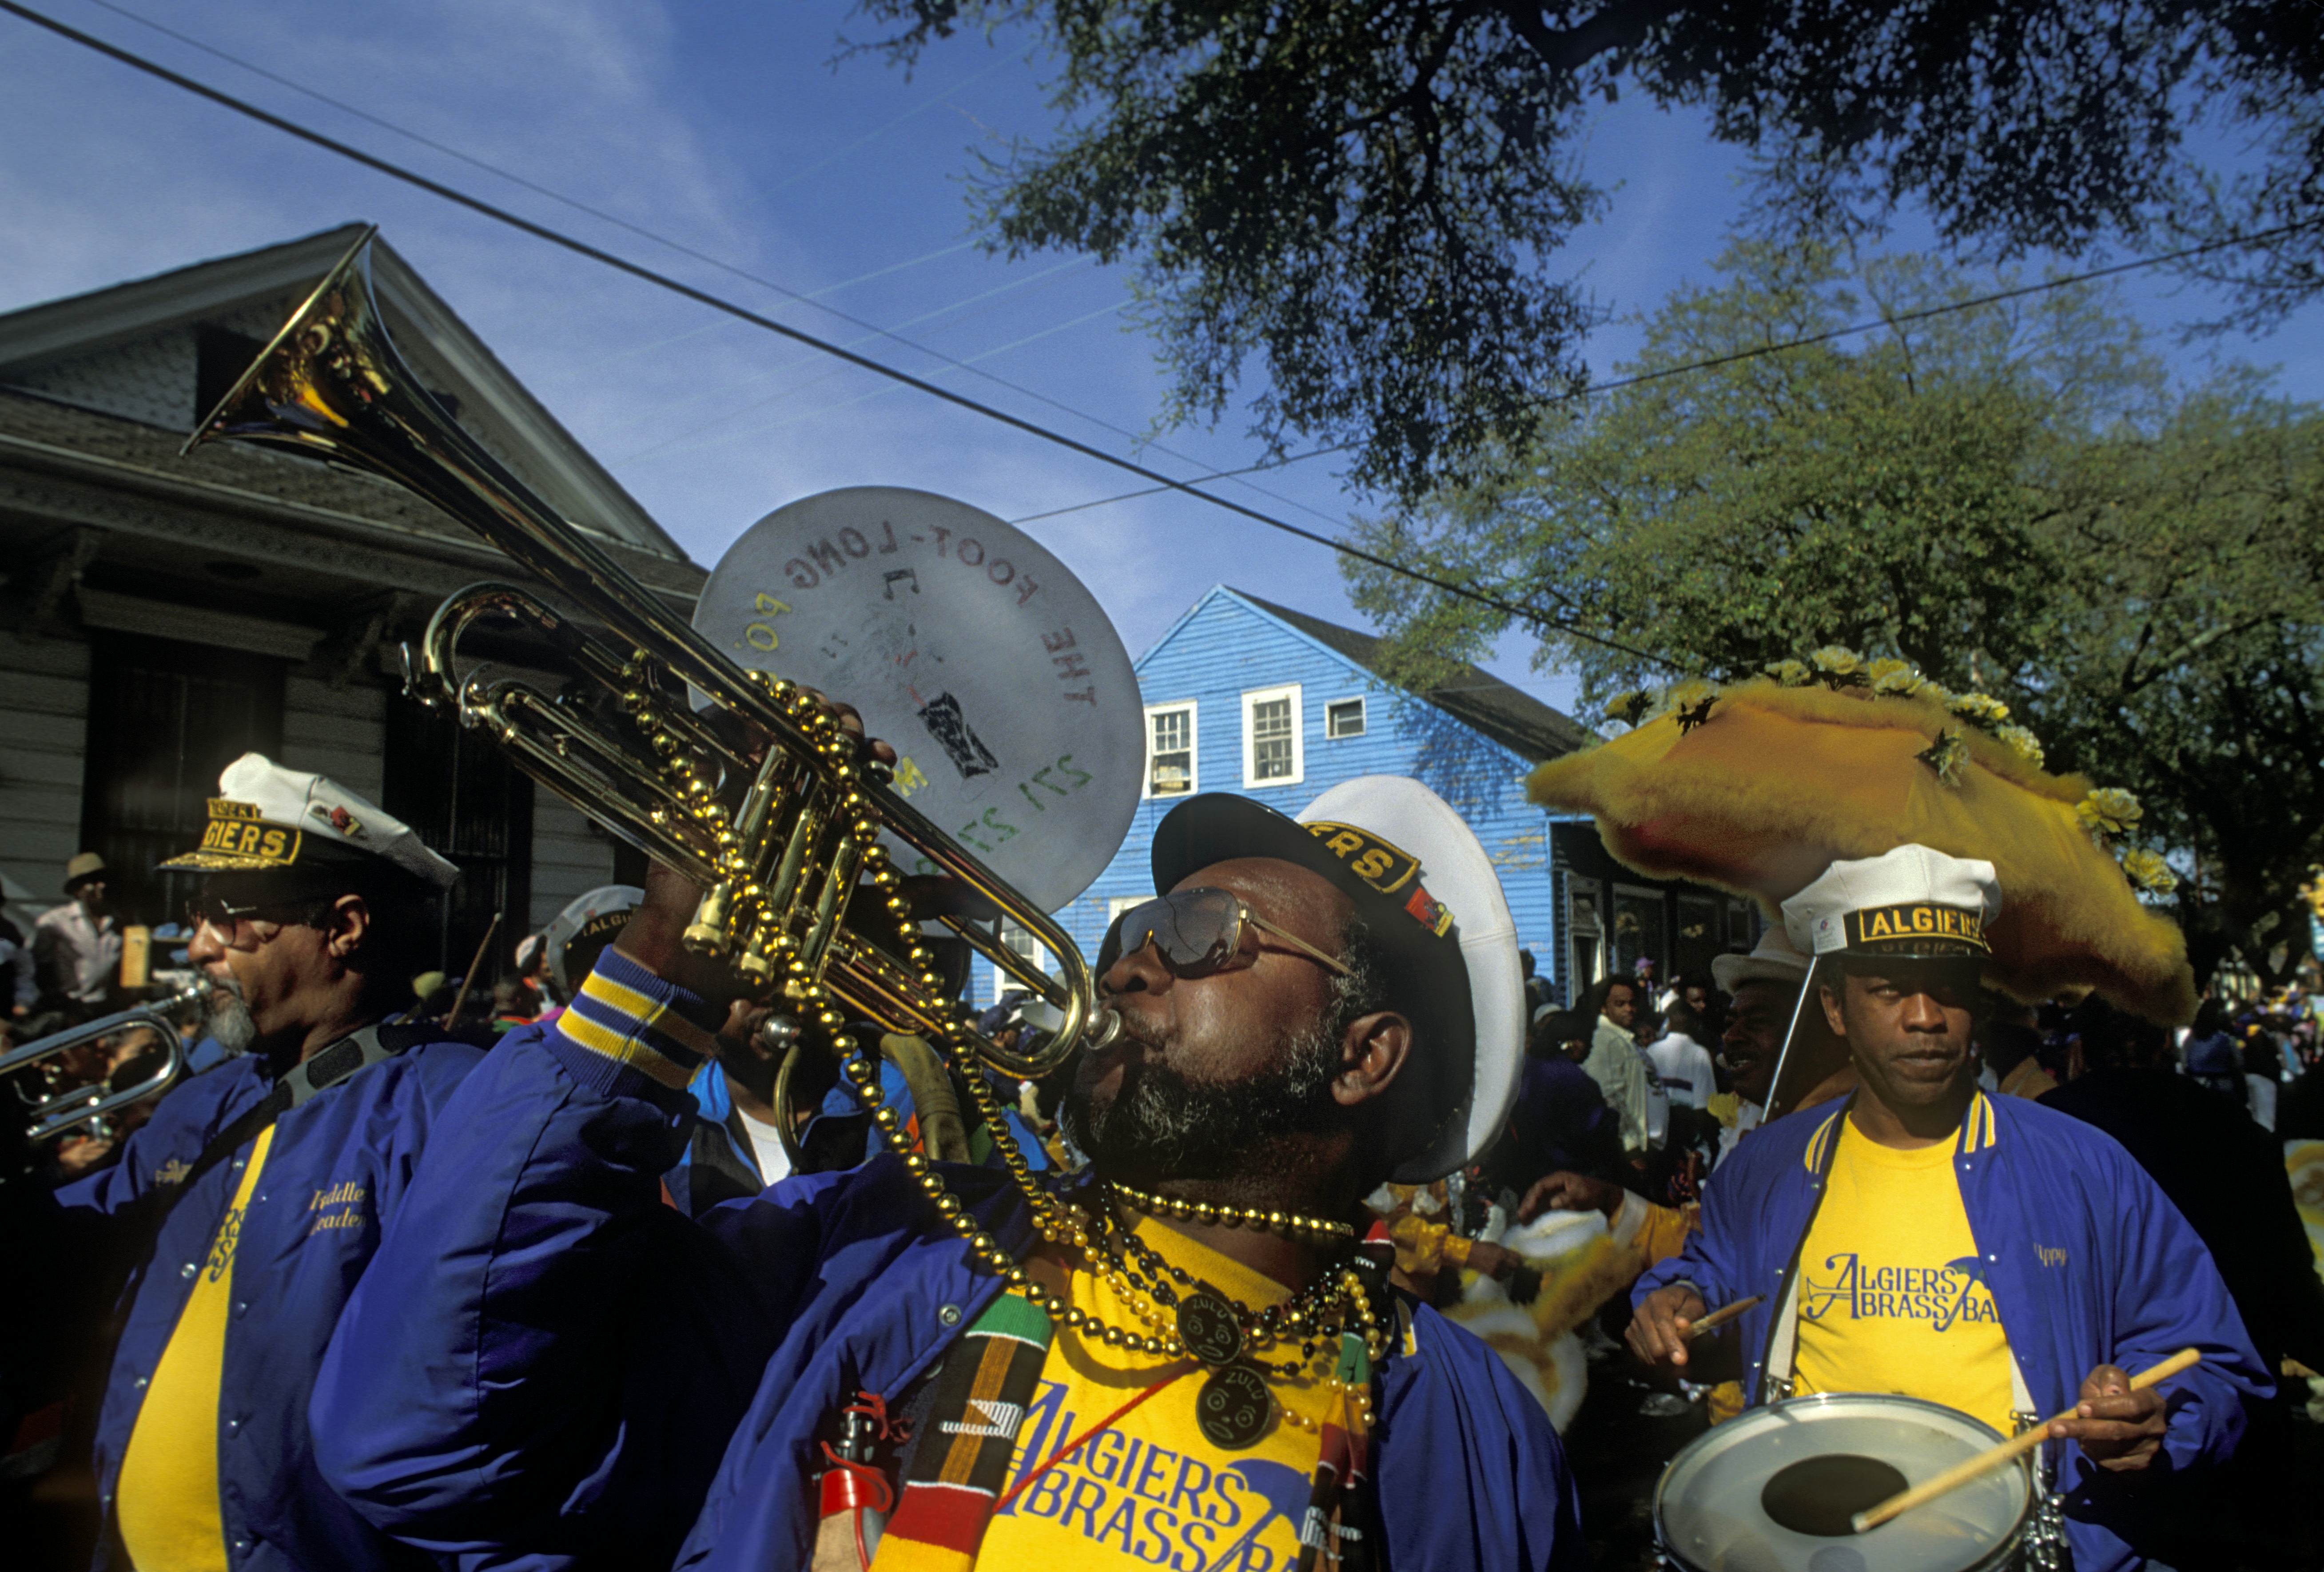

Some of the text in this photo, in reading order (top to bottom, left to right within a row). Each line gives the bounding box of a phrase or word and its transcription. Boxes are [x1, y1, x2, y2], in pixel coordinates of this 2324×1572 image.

[202, 820, 287, 857] GIERS
[589, 914, 631, 935] ALGI
[1806, 1253, 1957, 1320] ALGIERS
[1193, 1298, 1228, 1319] ZULU
[1861, 1293, 2002, 1324] BRASS BA
[1225, 1371, 1265, 1400] ZULU
[998, 1378, 1246, 1528] ALGIERS
[1022, 1468, 1216, 1572] BRASS
